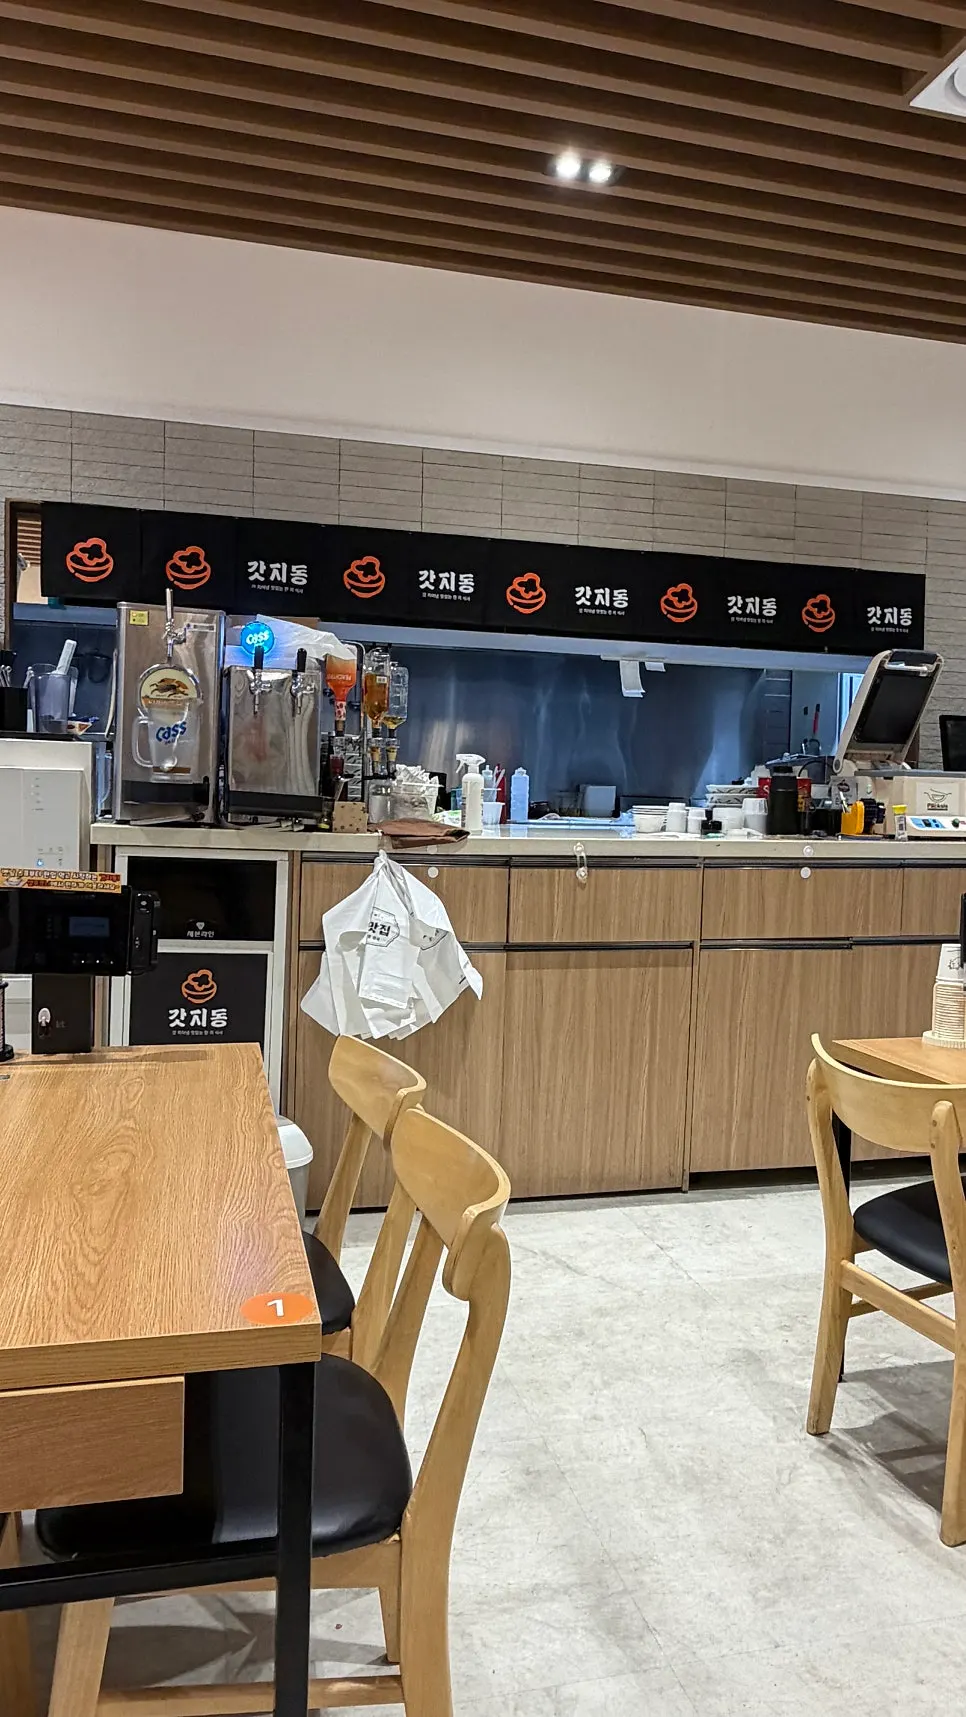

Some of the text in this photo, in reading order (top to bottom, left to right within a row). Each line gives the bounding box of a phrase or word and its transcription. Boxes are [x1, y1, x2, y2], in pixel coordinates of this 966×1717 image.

[247, 560, 308, 585] 갓지동
[418, 569, 475, 594] 갓지동
[575, 586, 629, 608] 갓지동
[727, 595, 777, 616] 갓지동
[867, 606, 912, 626] 갓지동
[168, 1008, 228, 1028] 갓지동
[266, 1299, 285, 1317] 1
